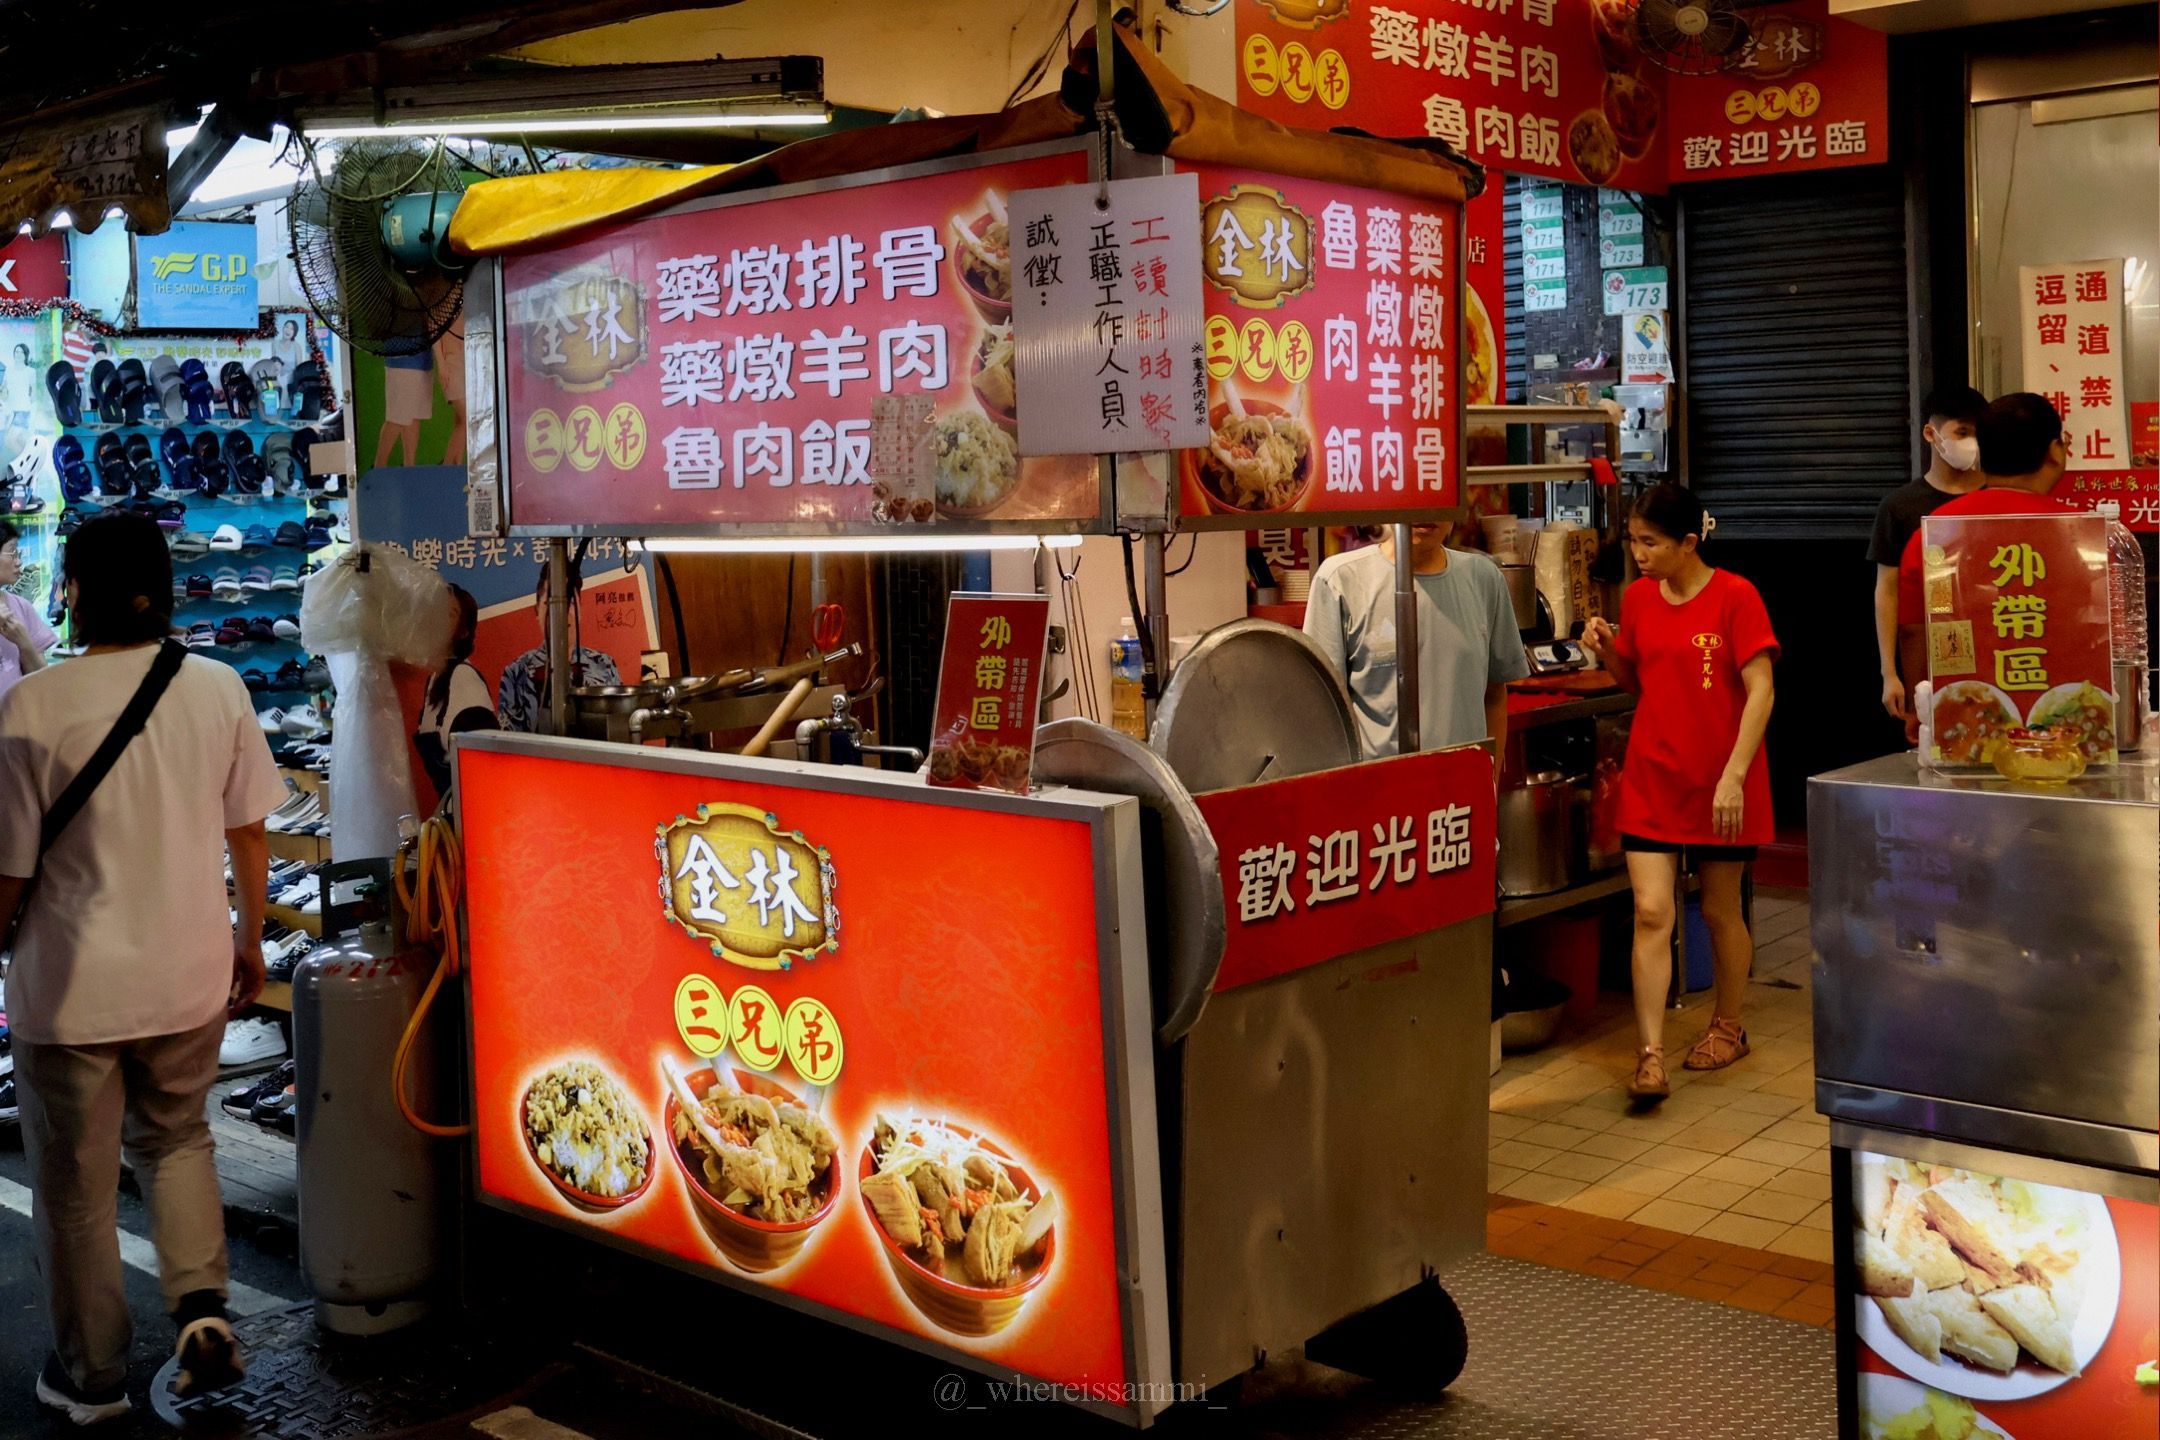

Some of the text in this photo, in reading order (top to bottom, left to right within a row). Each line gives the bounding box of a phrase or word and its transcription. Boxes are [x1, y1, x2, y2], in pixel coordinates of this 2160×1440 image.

[1248, 44, 1345, 103] 三兄弟
[1369, 6, 1559, 97] 藥燉羊肉
[1422, 93, 1562, 167] 魯肉飯
[1730, 87, 1816, 117] 三兄弟
[1683, 119, 1867, 170] 歡迎光臨
[1207, 208, 1305, 283] 金林
[1533, 202, 1552, 216] 171
[1534, 233, 1553, 247] 171
[1611, 218, 1633, 232] 173
[201, 253, 247, 283] G.P
[655, 224, 945, 323] 藥燉排骨
[1467, 236, 1486, 264] 店
[1535, 263, 1554, 277] 171
[1612, 250, 1634, 264] 173
[153, 282, 248, 295] THE SANDAL EXPERT
[1088, 220, 1128, 430] 正職工作人員
[1536, 293, 1556, 307] 171
[1627, 286, 1661, 308] 173
[660, 319, 950, 407] 藥燉羊肉
[1205, 320, 1310, 376] 三兄弟
[1320, 200, 1364, 494] 魯肉飯
[1366, 206, 1403, 492] 藥燉羊肉
[1408, 212, 1446, 493] 藥燉排骨
[2035, 274, 2073, 459] 逗留、排
[2075, 271, 2115, 460] 通道禁止
[530, 409, 642, 464] 三兄弟
[661, 417, 872, 491] 魯肉飯
[380, 537, 508, 571] 樂時光
[1989, 543, 2050, 693] 外帶區
[970, 615, 1011, 731] 外帶區
[676, 833, 820, 938] 金林
[1237, 802, 1472, 923] 歡迎光臨
[684, 987, 835, 1077] 三兄弟
